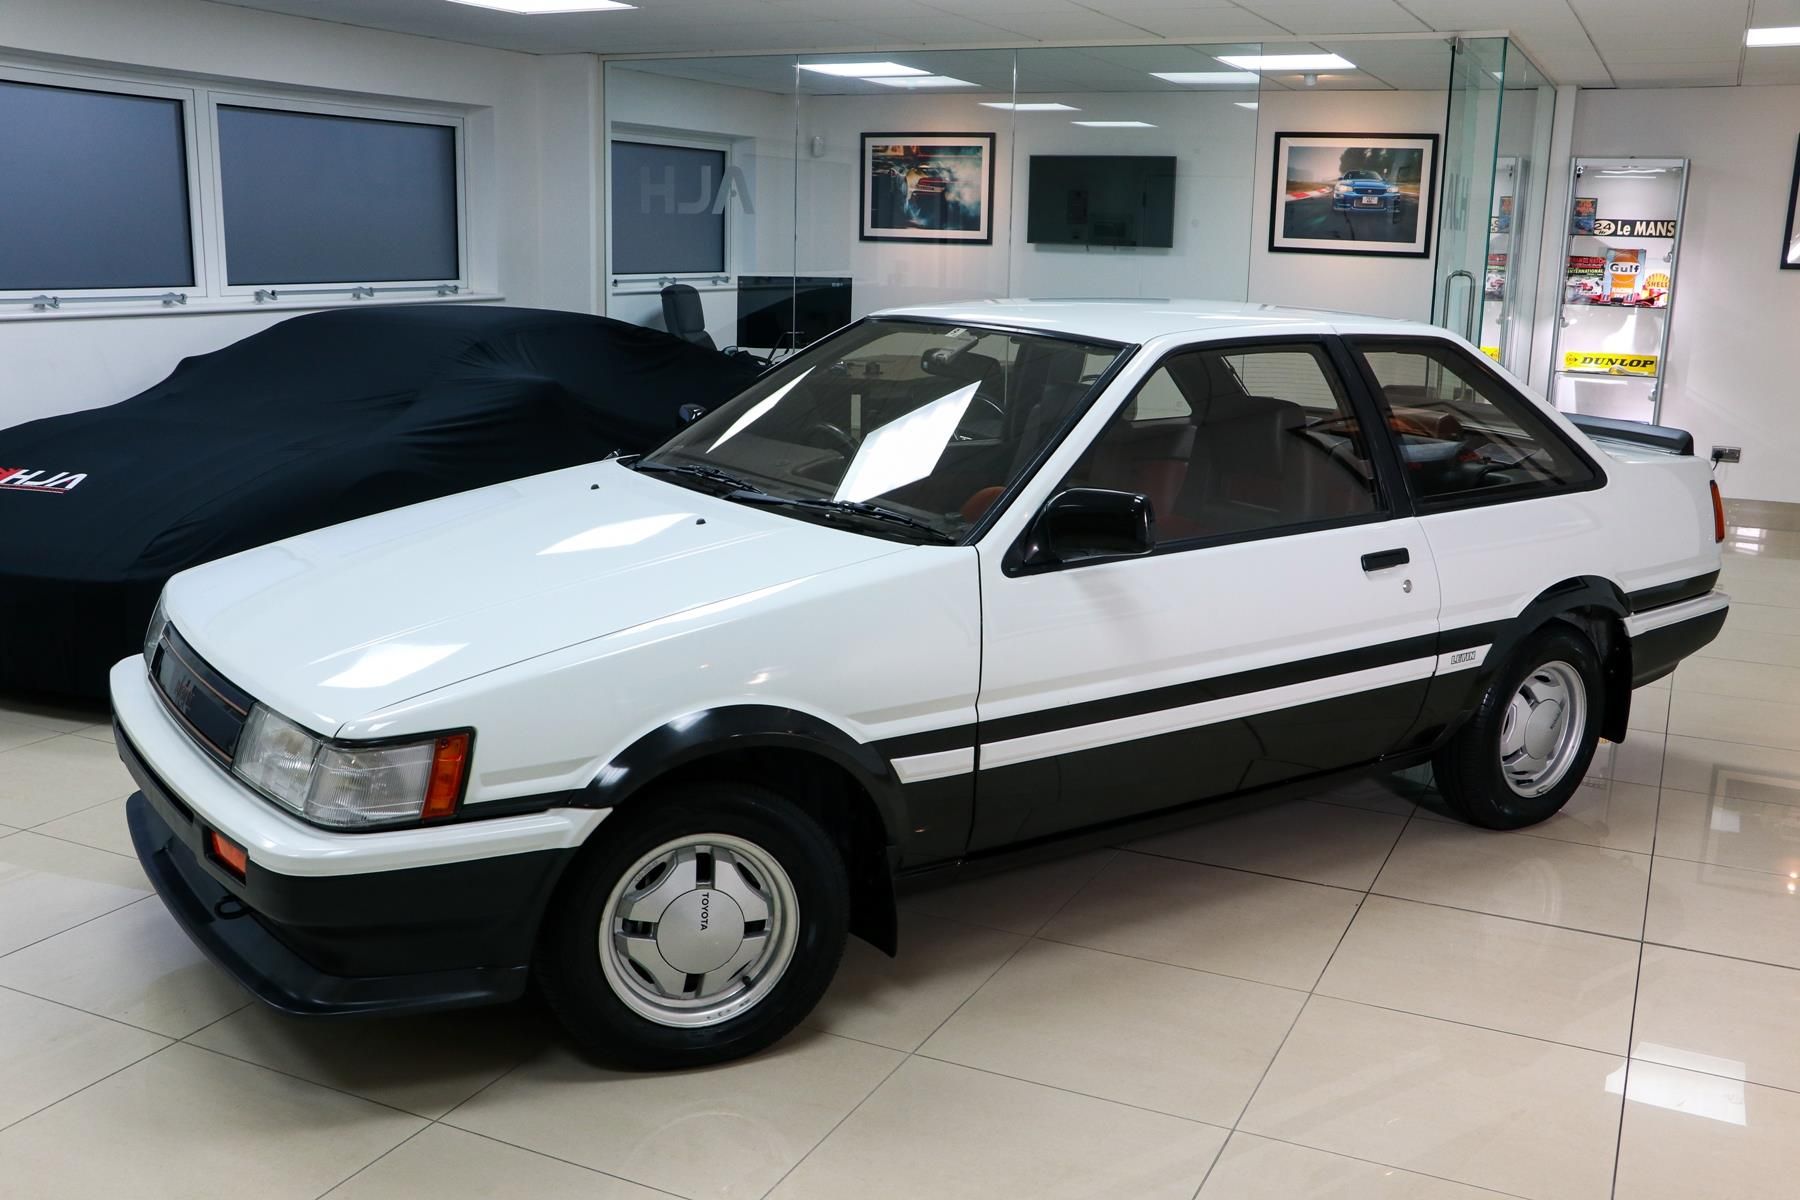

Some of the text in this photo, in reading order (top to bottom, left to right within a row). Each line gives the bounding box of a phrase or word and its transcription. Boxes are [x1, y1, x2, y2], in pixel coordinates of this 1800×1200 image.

[1594, 222, 1612, 230] 24
[1617, 221, 1675, 237] Le MANS
[1610, 263, 1640, 273] Gulf
[1581, 356, 1655, 368] DUNLOP
[700, 892, 710, 931] TOYOTA
